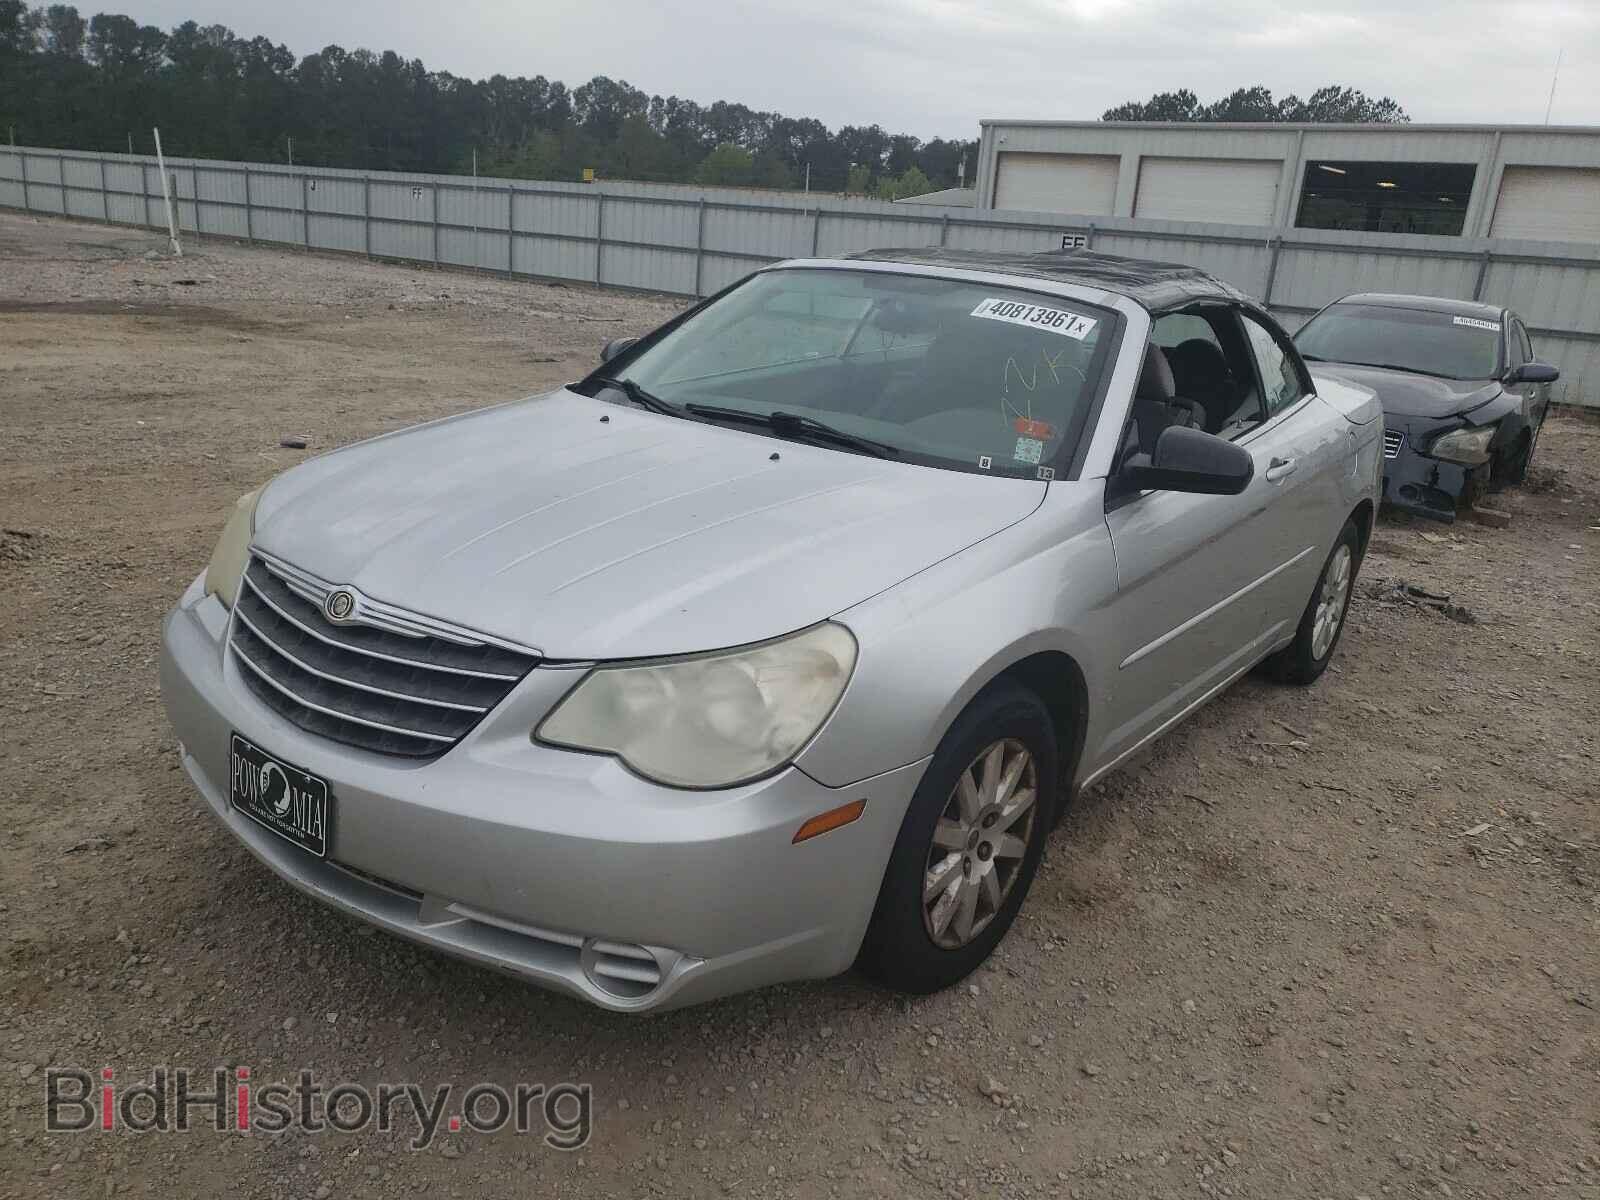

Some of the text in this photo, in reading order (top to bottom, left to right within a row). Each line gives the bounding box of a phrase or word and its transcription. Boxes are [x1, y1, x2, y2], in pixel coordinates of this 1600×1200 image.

[989, 301, 1079, 331] 40813961
[233, 752, 323, 840] POW MIA
